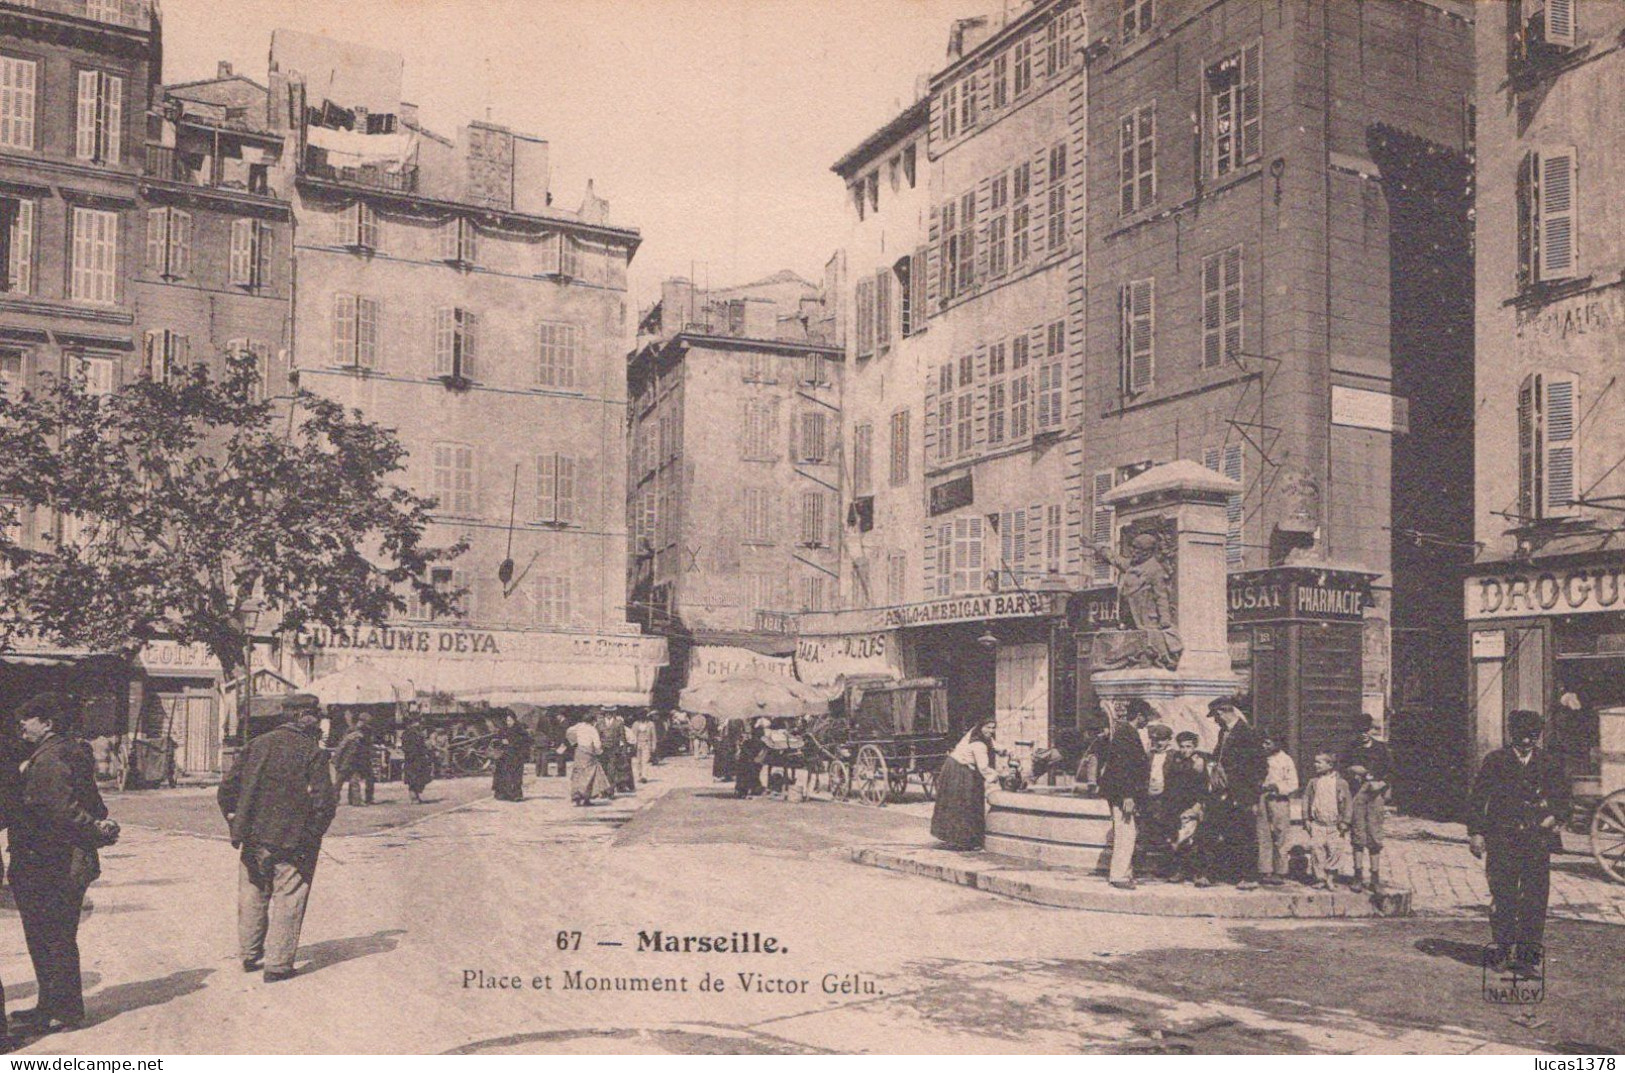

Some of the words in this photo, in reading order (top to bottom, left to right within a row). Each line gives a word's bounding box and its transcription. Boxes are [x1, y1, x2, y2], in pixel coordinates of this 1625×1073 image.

[995, 593, 1026, 614] BAR
[1298, 586, 1362, 615] PHARMACIE
[1480, 570, 1625, 613] DROGU
